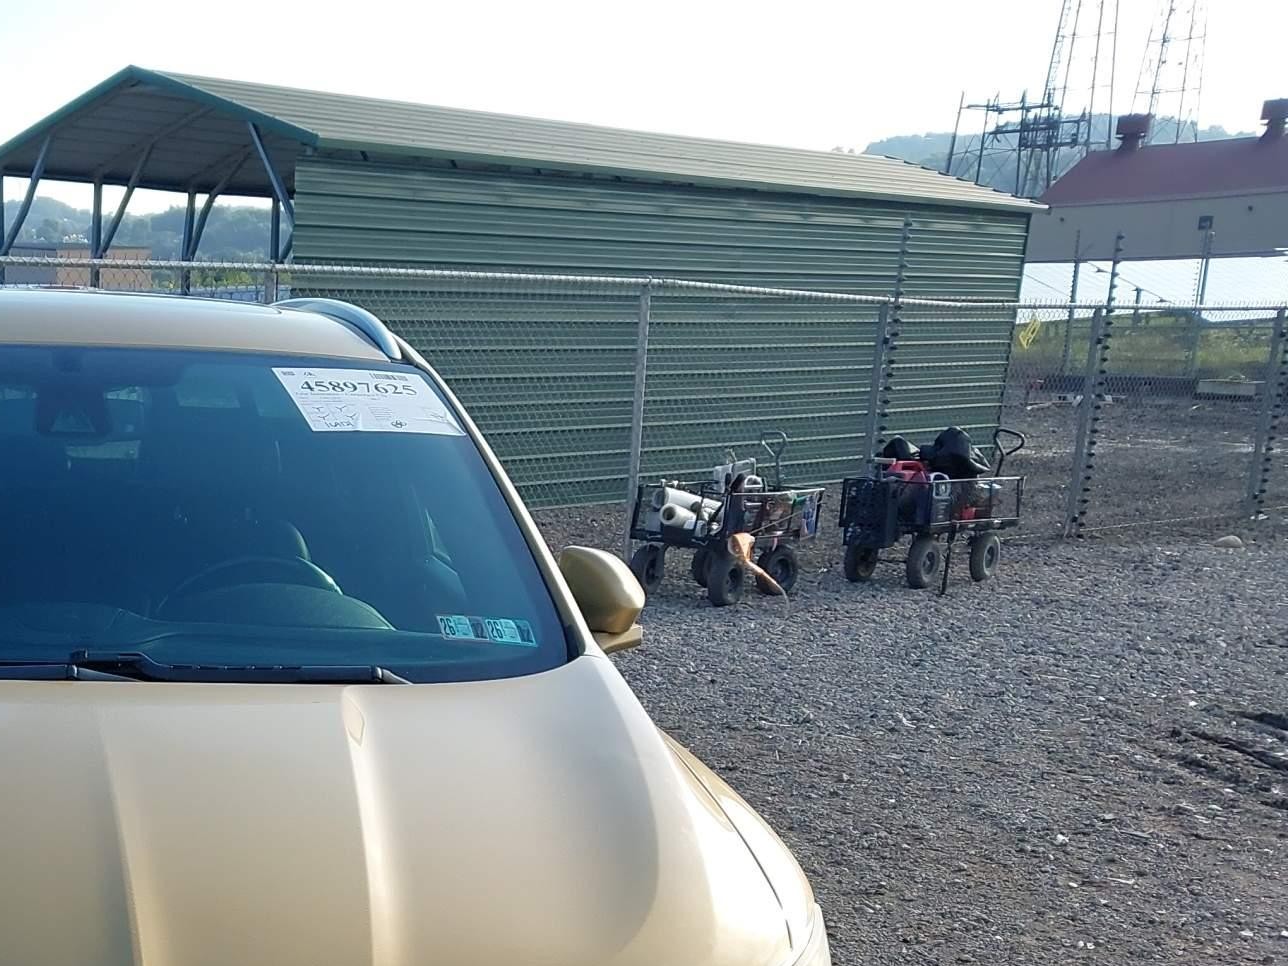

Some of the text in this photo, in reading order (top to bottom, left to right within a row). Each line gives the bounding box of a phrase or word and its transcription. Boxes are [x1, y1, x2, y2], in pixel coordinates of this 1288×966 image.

[300, 380, 417, 396] 45897625
[440, 618, 456, 635] 26
[487, 621, 504, 639] 26
